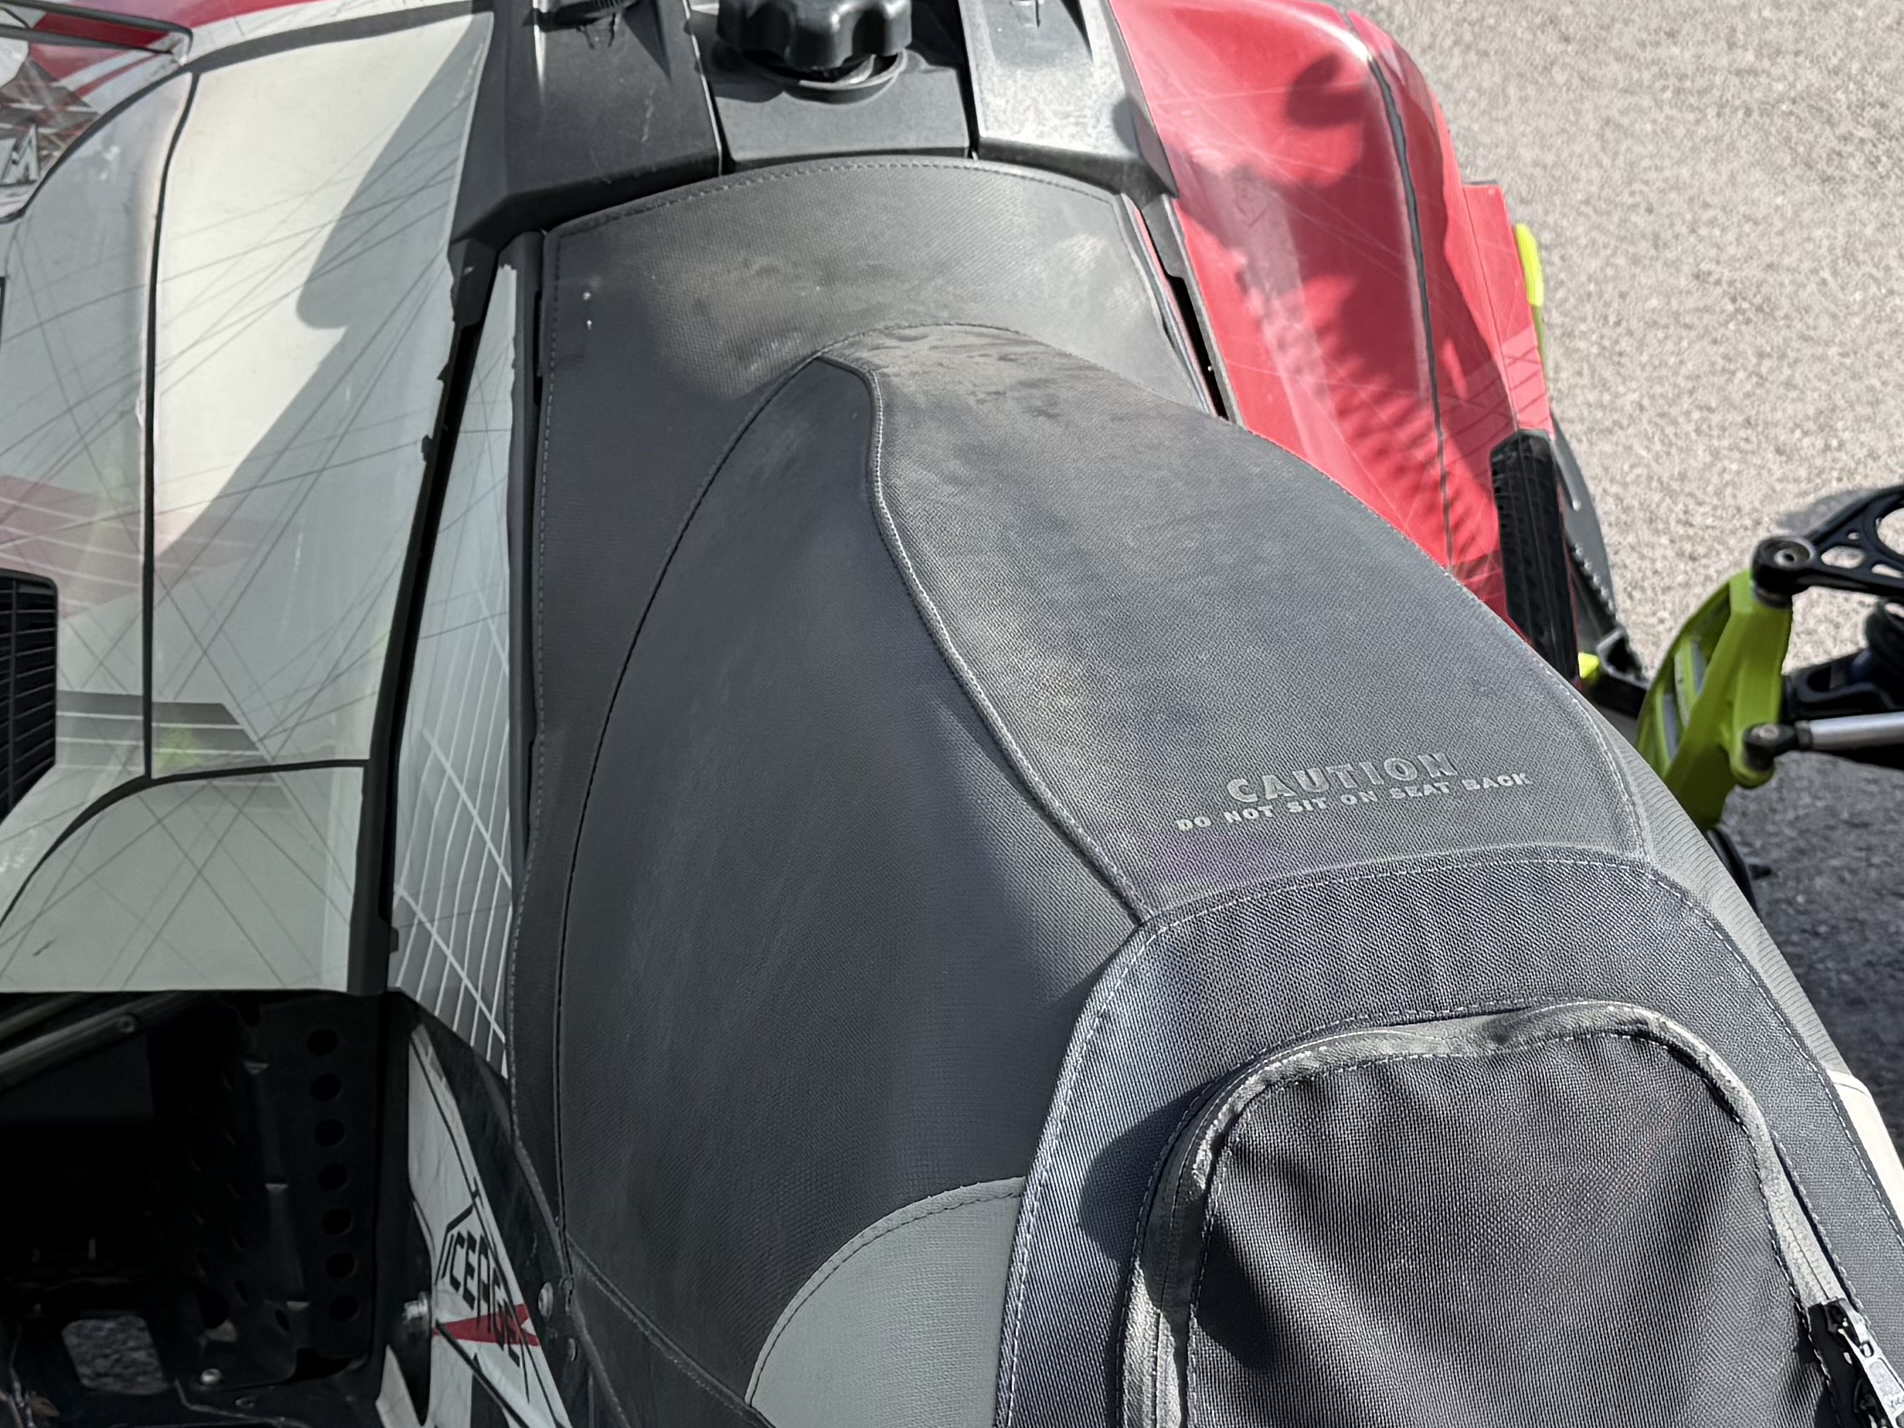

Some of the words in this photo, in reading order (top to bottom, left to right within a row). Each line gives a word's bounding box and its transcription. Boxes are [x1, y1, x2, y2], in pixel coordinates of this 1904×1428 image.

[1176, 816, 1212, 832] DO
[1223, 805, 1274, 824] NOT
[1287, 797, 1327, 814] SIT
[1340, 790, 1378, 806] ON
[1389, 782, 1450, 799] SEAT
[1461, 772, 1532, 791] BACK
[1226, 752, 1458, 803] CAUTION
